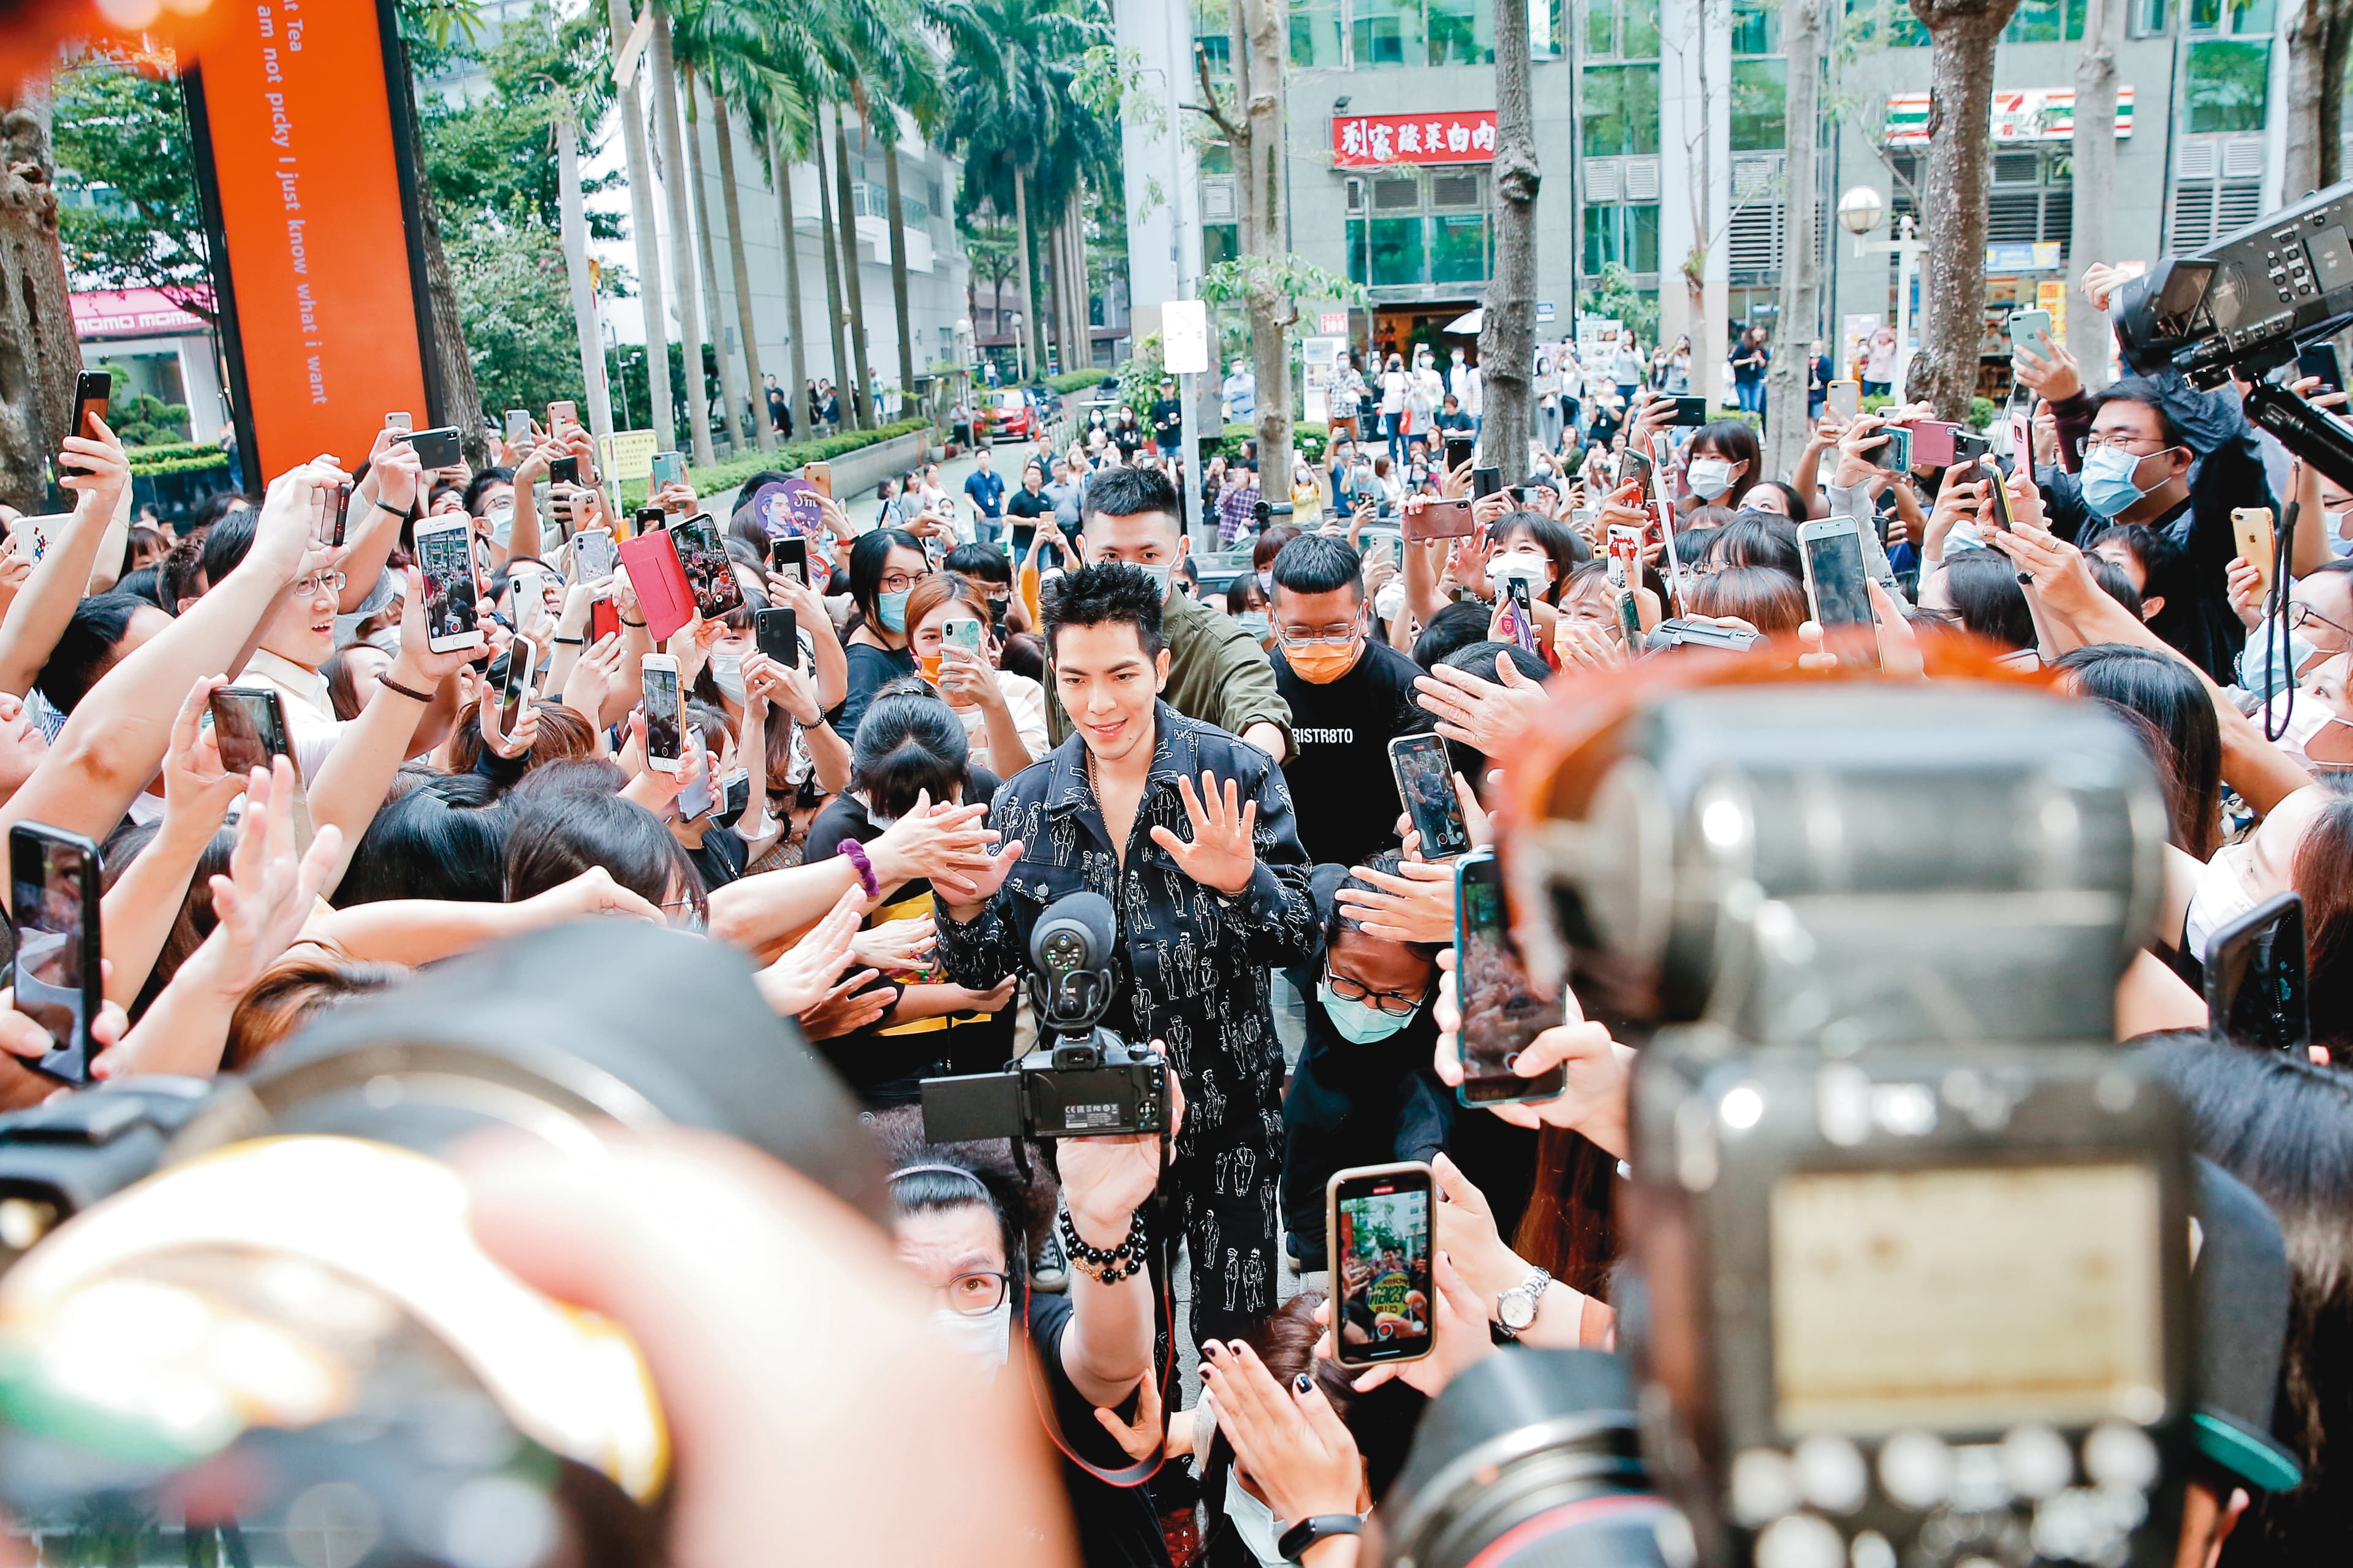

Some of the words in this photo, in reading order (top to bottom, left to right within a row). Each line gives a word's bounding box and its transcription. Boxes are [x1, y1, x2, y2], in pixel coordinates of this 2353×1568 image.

[257, 4, 275, 37] am
[284, 0, 299, 11] t
[287, 18, 304, 51] Tea
[263, 47, 283, 83] not
[265, 93, 292, 147] picky
[276, 170, 300, 210] just
[287, 219, 308, 274] know
[297, 282, 317, 333] what
[308, 355, 328, 404] want
[1291, 728, 1353, 743] RISTR8TO
